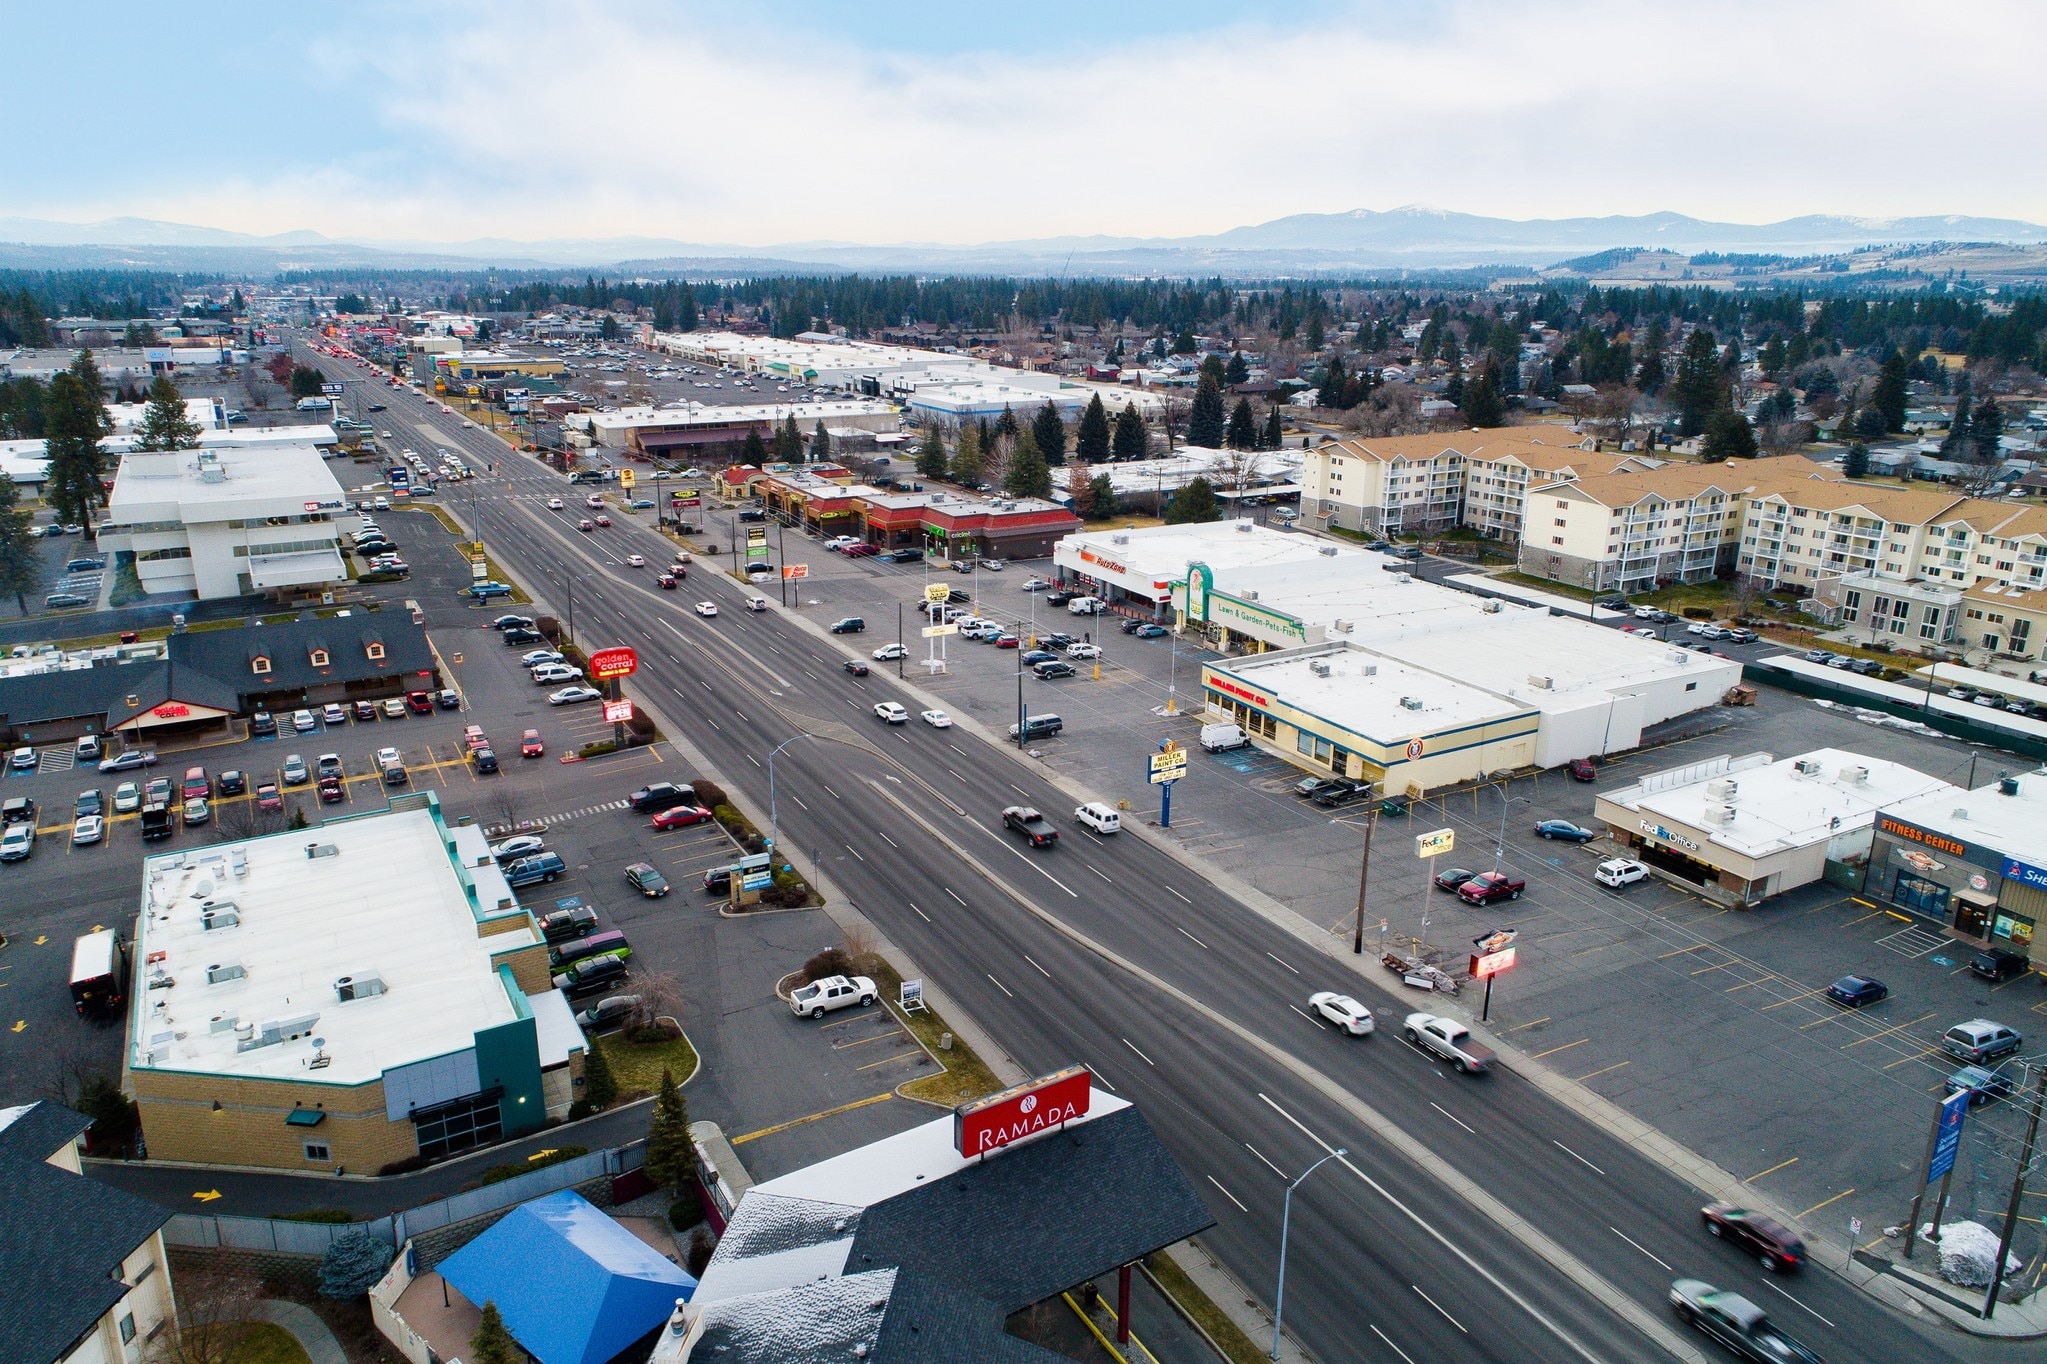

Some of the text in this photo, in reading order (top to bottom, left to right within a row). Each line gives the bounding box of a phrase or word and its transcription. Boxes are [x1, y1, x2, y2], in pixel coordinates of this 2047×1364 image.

[1218, 603, 1234, 615] Lawn
[1235, 609, 1240, 618] &
[594, 654, 630, 667] golden
[601, 659, 633, 670] corral
[607, 708, 631, 720] OPEN
[1157, 752, 1181, 762] MILLER
[1154, 761, 1173, 769] PAINT
[1640, 819, 1698, 850] FedEx Office
[1883, 818, 1923, 841] FITNESS
[1925, 834, 1964, 856] CENTER
[1422, 836, 1444, 848] FedEx
[1433, 844, 1452, 853] Office
[979, 1101, 1076, 1151] RAMADA
